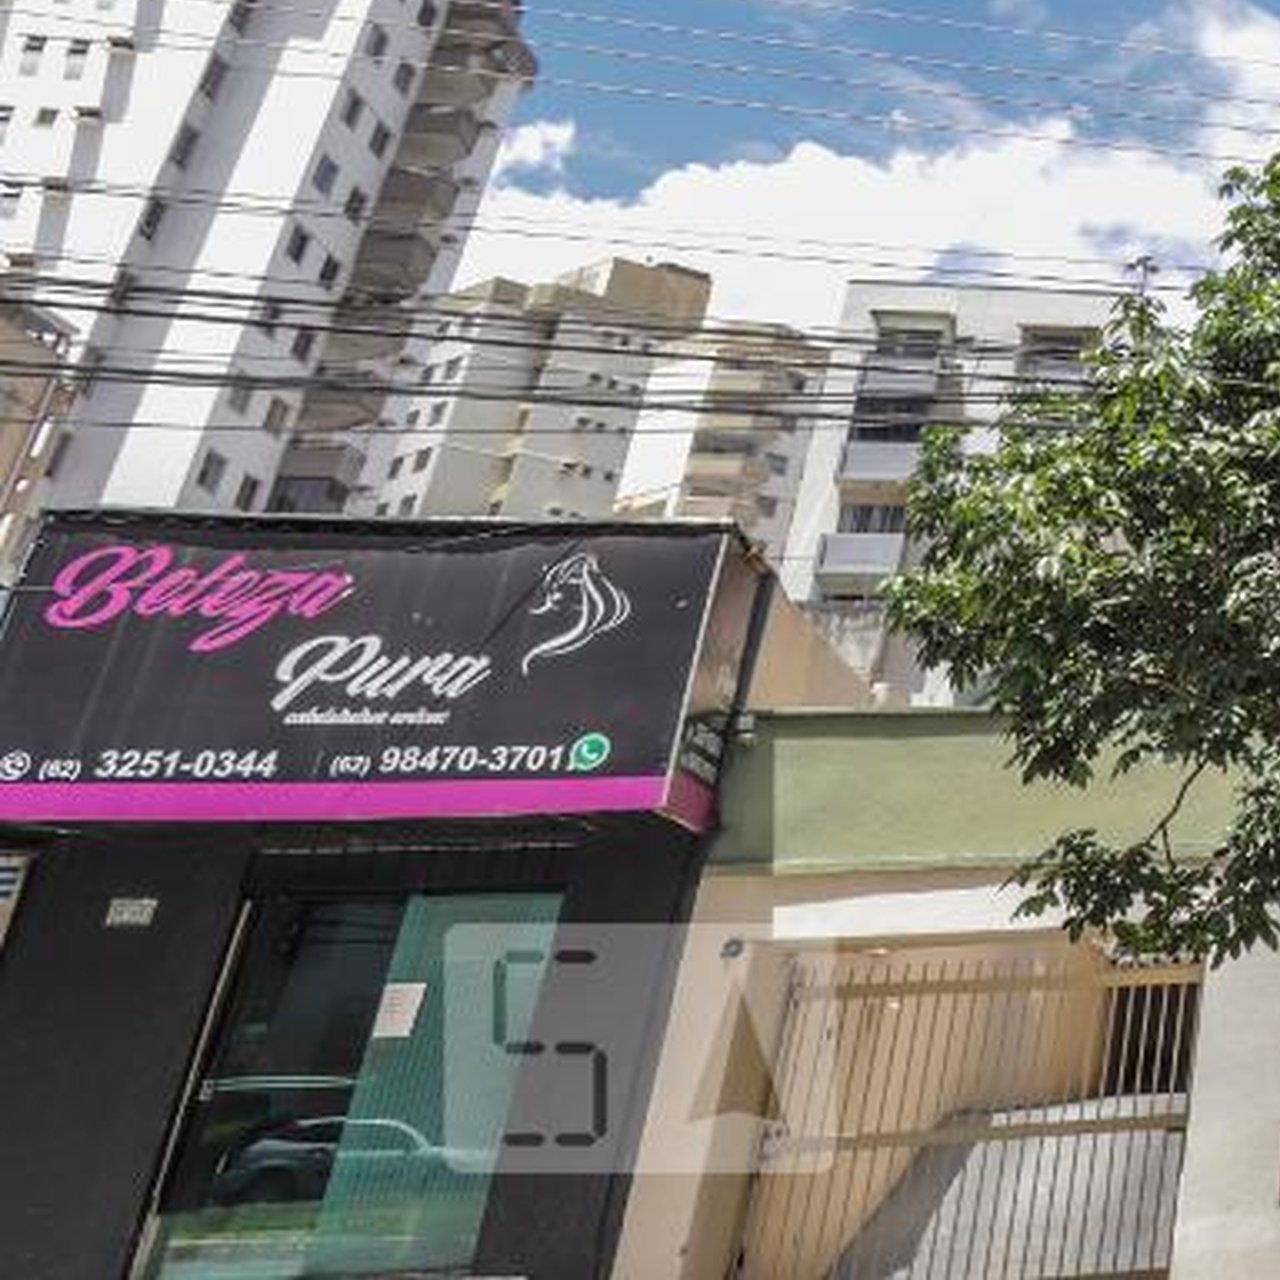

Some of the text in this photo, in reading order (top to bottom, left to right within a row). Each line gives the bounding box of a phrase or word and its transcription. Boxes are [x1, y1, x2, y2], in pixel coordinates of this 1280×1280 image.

[45, 545, 353, 651] Beleza
[270, 634, 491, 711] Pura
[95, 749, 279, 778] 3251-0344
[378, 745, 565, 772] 98470-3701
